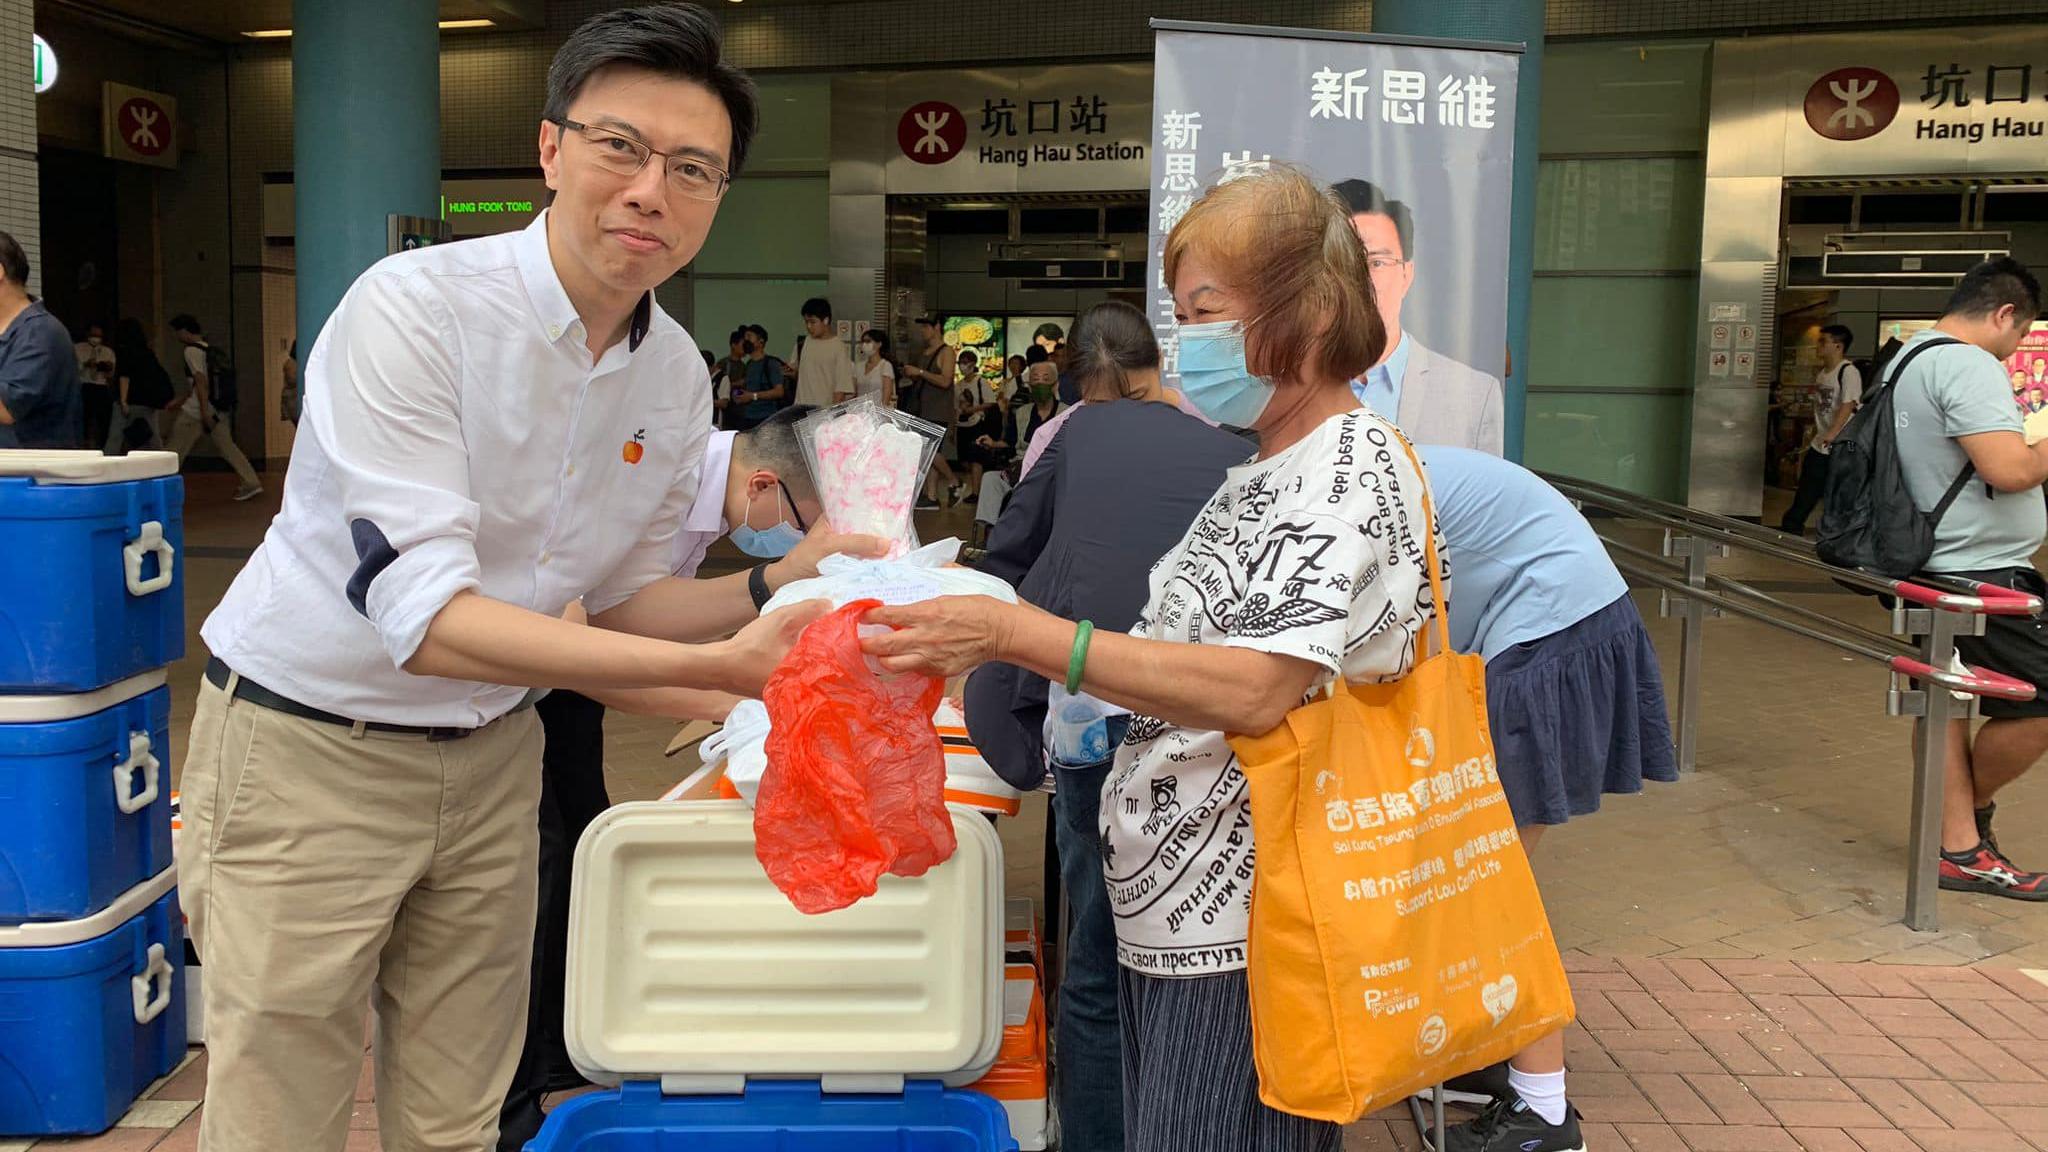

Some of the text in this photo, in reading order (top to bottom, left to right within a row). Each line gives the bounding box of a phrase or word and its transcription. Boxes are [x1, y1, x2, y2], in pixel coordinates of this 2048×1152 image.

[1310, 66, 1496, 129] 新思維
[1919, 63, 2048, 109] 坑口
[980, 95, 1108, 138] 坑口站
[1916, 117, 2044, 143] Hang Hau
[979, 142, 1144, 167] Hang Hau Station
[449, 201, 532, 213] HUNG FOOK TONG
[1478, 859, 1502, 880] Life
[1161, 947, 1245, 974] преступ
